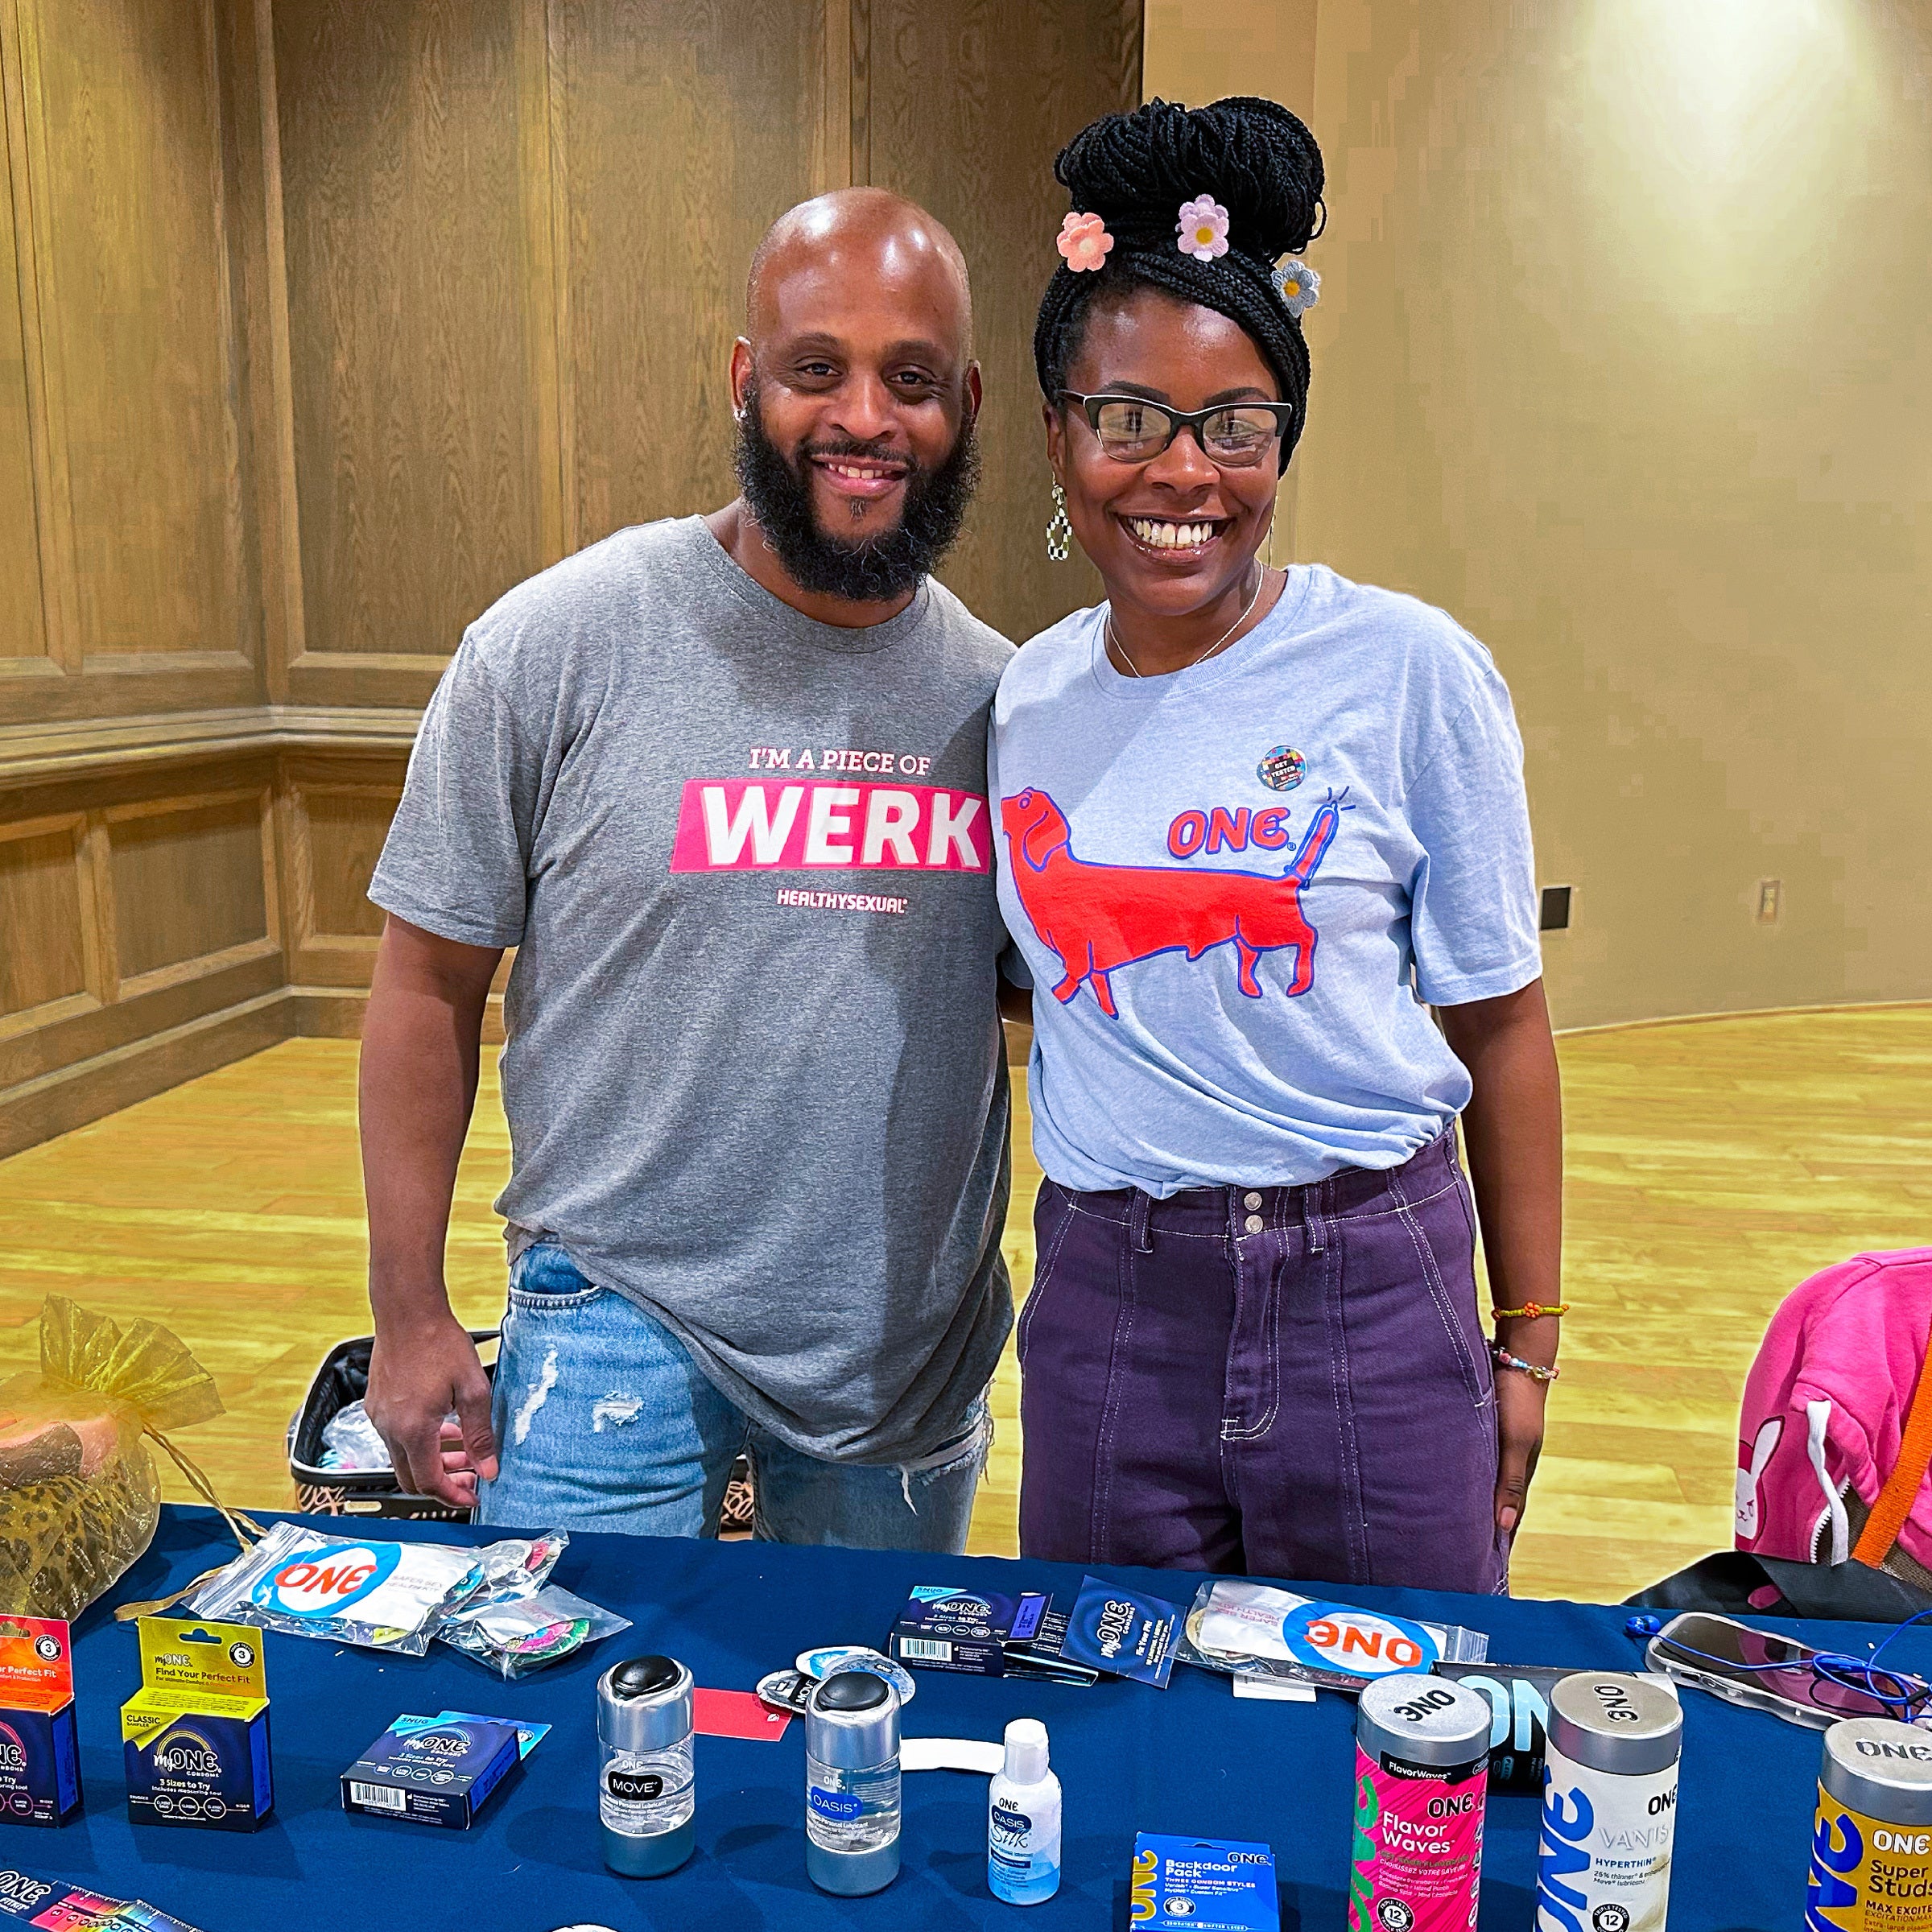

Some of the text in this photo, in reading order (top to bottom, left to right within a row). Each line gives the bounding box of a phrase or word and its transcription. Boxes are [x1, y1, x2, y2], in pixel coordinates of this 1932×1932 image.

[749, 747, 931, 777] I'M A PIECE OF
[700, 785, 982, 869] WERK
[1167, 807, 1291, 860] ONE
[275, 1563, 378, 1595] ONE
[1302, 1620, 1423, 1667] ONE
[238, 1650, 246, 1659] 3
[8, 1666, 42, 1677] Perfect
[43, 1669, 57, 1678] Fit
[155, 1667, 250, 1684] Find Your Perfect Fit
[1393, 1689, 1455, 1722] ONE
[1593, 1685, 1638, 1723] ONE
[126, 1715, 160, 1724] CLASSIC
[621, 1759, 644, 1769] ONE
[3, 1776, 16, 1785] Try
[166, 1779, 186, 1788] Sizes
[187, 1780, 196, 1789] to
[198, 1781, 211, 1791] Try
[613, 1778, 654, 1794] MOVE
[824, 1775, 843, 1788] ONE
[813, 1794, 853, 1813] OASIS
[999, 1797, 1018, 1812] ONE
[1427, 1792, 1475, 1818] ONE
[1649, 1783, 1678, 1816] ONE
[993, 1811, 1025, 1828] OASIS
[1383, 1810, 1447, 1837] Flavor
[991, 1824, 1029, 1848] Silk
[1381, 1827, 1451, 1854] Waves
[1599, 1824, 1672, 1851] VANIS
[1872, 1829, 1931, 1856] ONE
[1166, 1859, 1238, 1872] Backdoor
[1228, 1852, 1269, 1865] ONE
[1380, 1858, 1417, 1875] CHOISISSEZ
[1166, 1867, 1202, 1878] Pack
[1870, 1859, 1929, 1880] Super
[1176, 1902, 1184, 1910] 3
[1389, 1908, 1402, 1920] 12
[1866, 1900, 1932, 1916] MAX EXCITE
[1604, 1914, 1619, 1926] 12
[1865, 1909, 1914, 1922] EXCITATION
